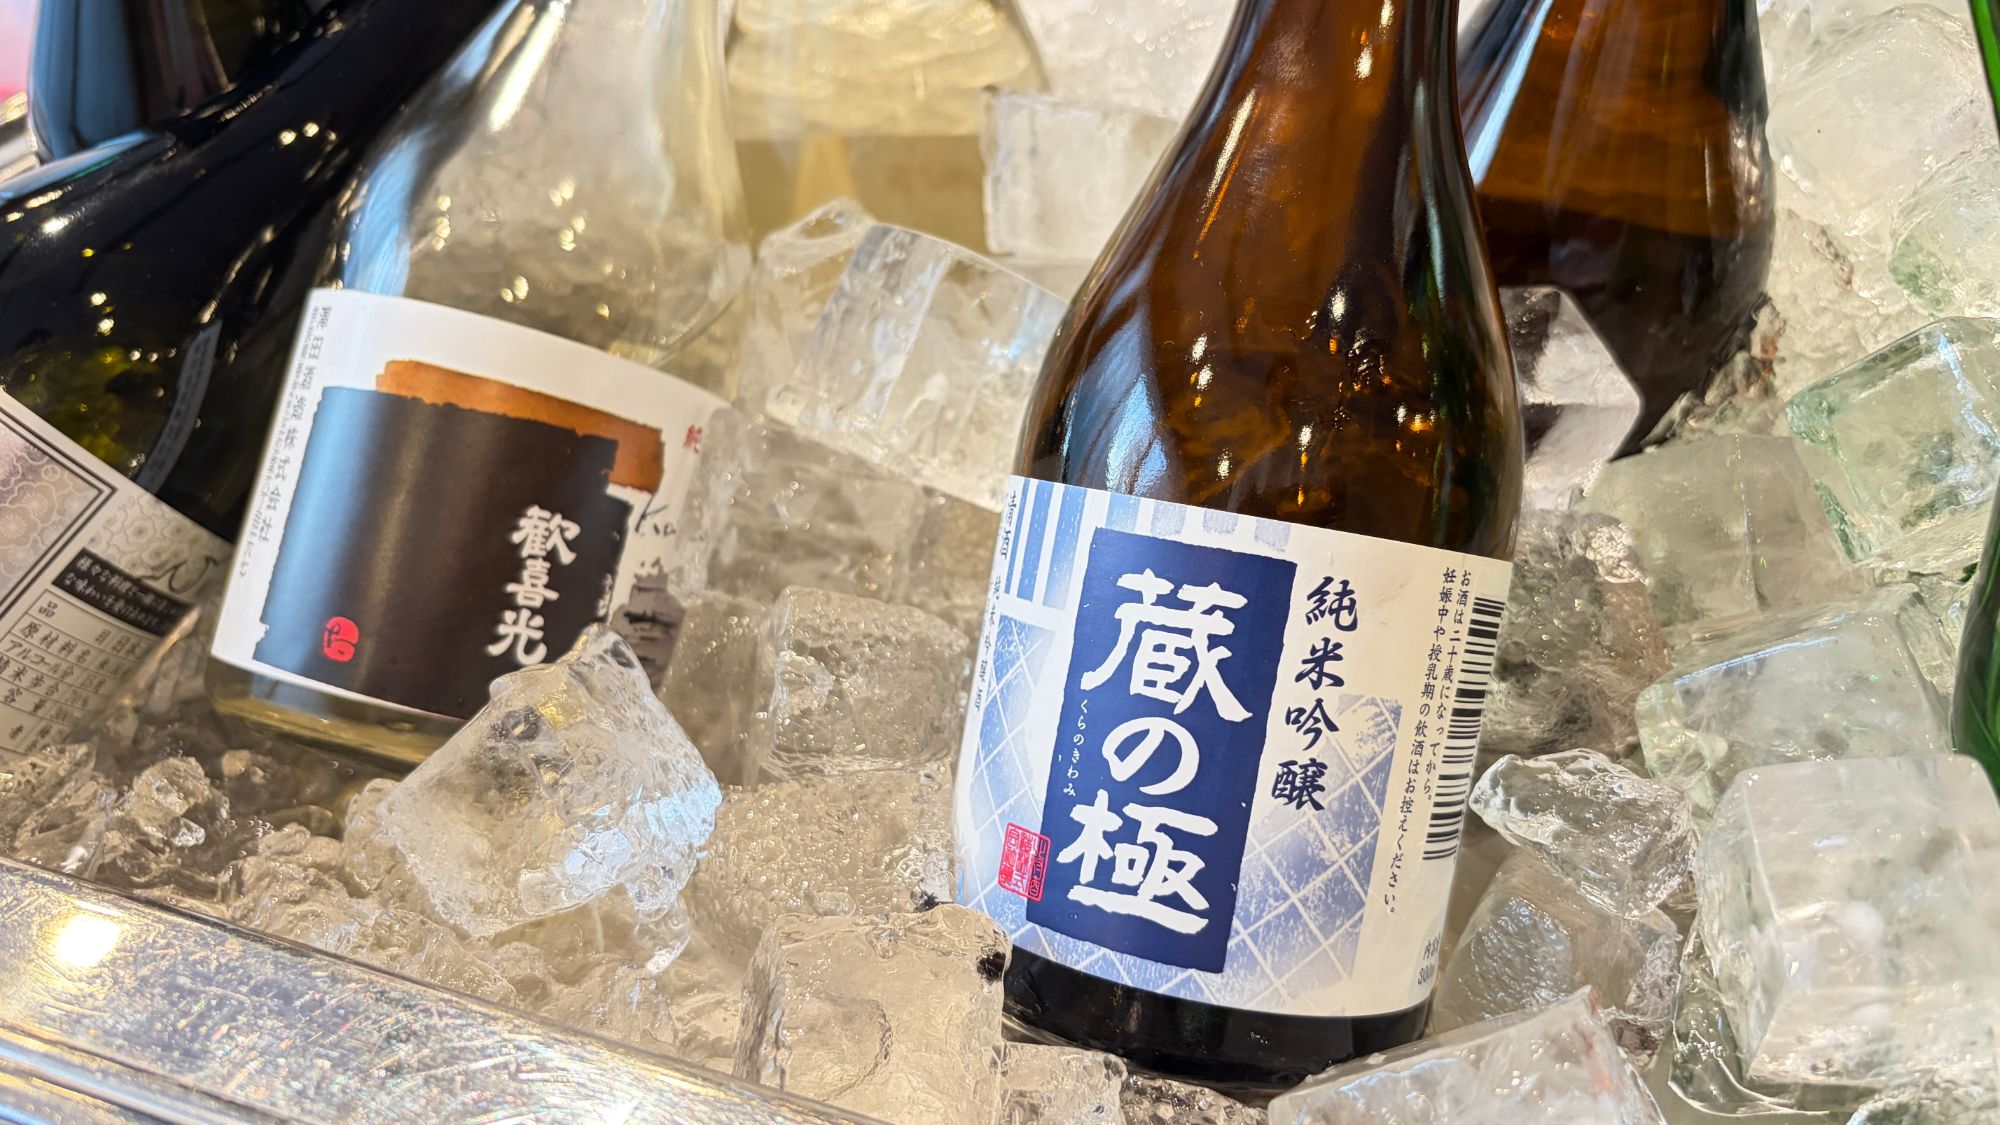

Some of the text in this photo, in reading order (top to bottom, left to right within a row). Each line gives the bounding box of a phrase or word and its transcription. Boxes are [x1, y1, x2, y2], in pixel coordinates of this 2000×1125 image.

[1056, 567, 1252, 935] 蔵の極
[1063, 697, 1090, 797] くらのきわみ
[1271, 575, 1359, 812] 純米吟醸
[1383, 566, 1457, 915] 妊娠中や授乳期の飲酒はお控えください。
[1423, 568, 1473, 801] お酒は二十歳になってから。
